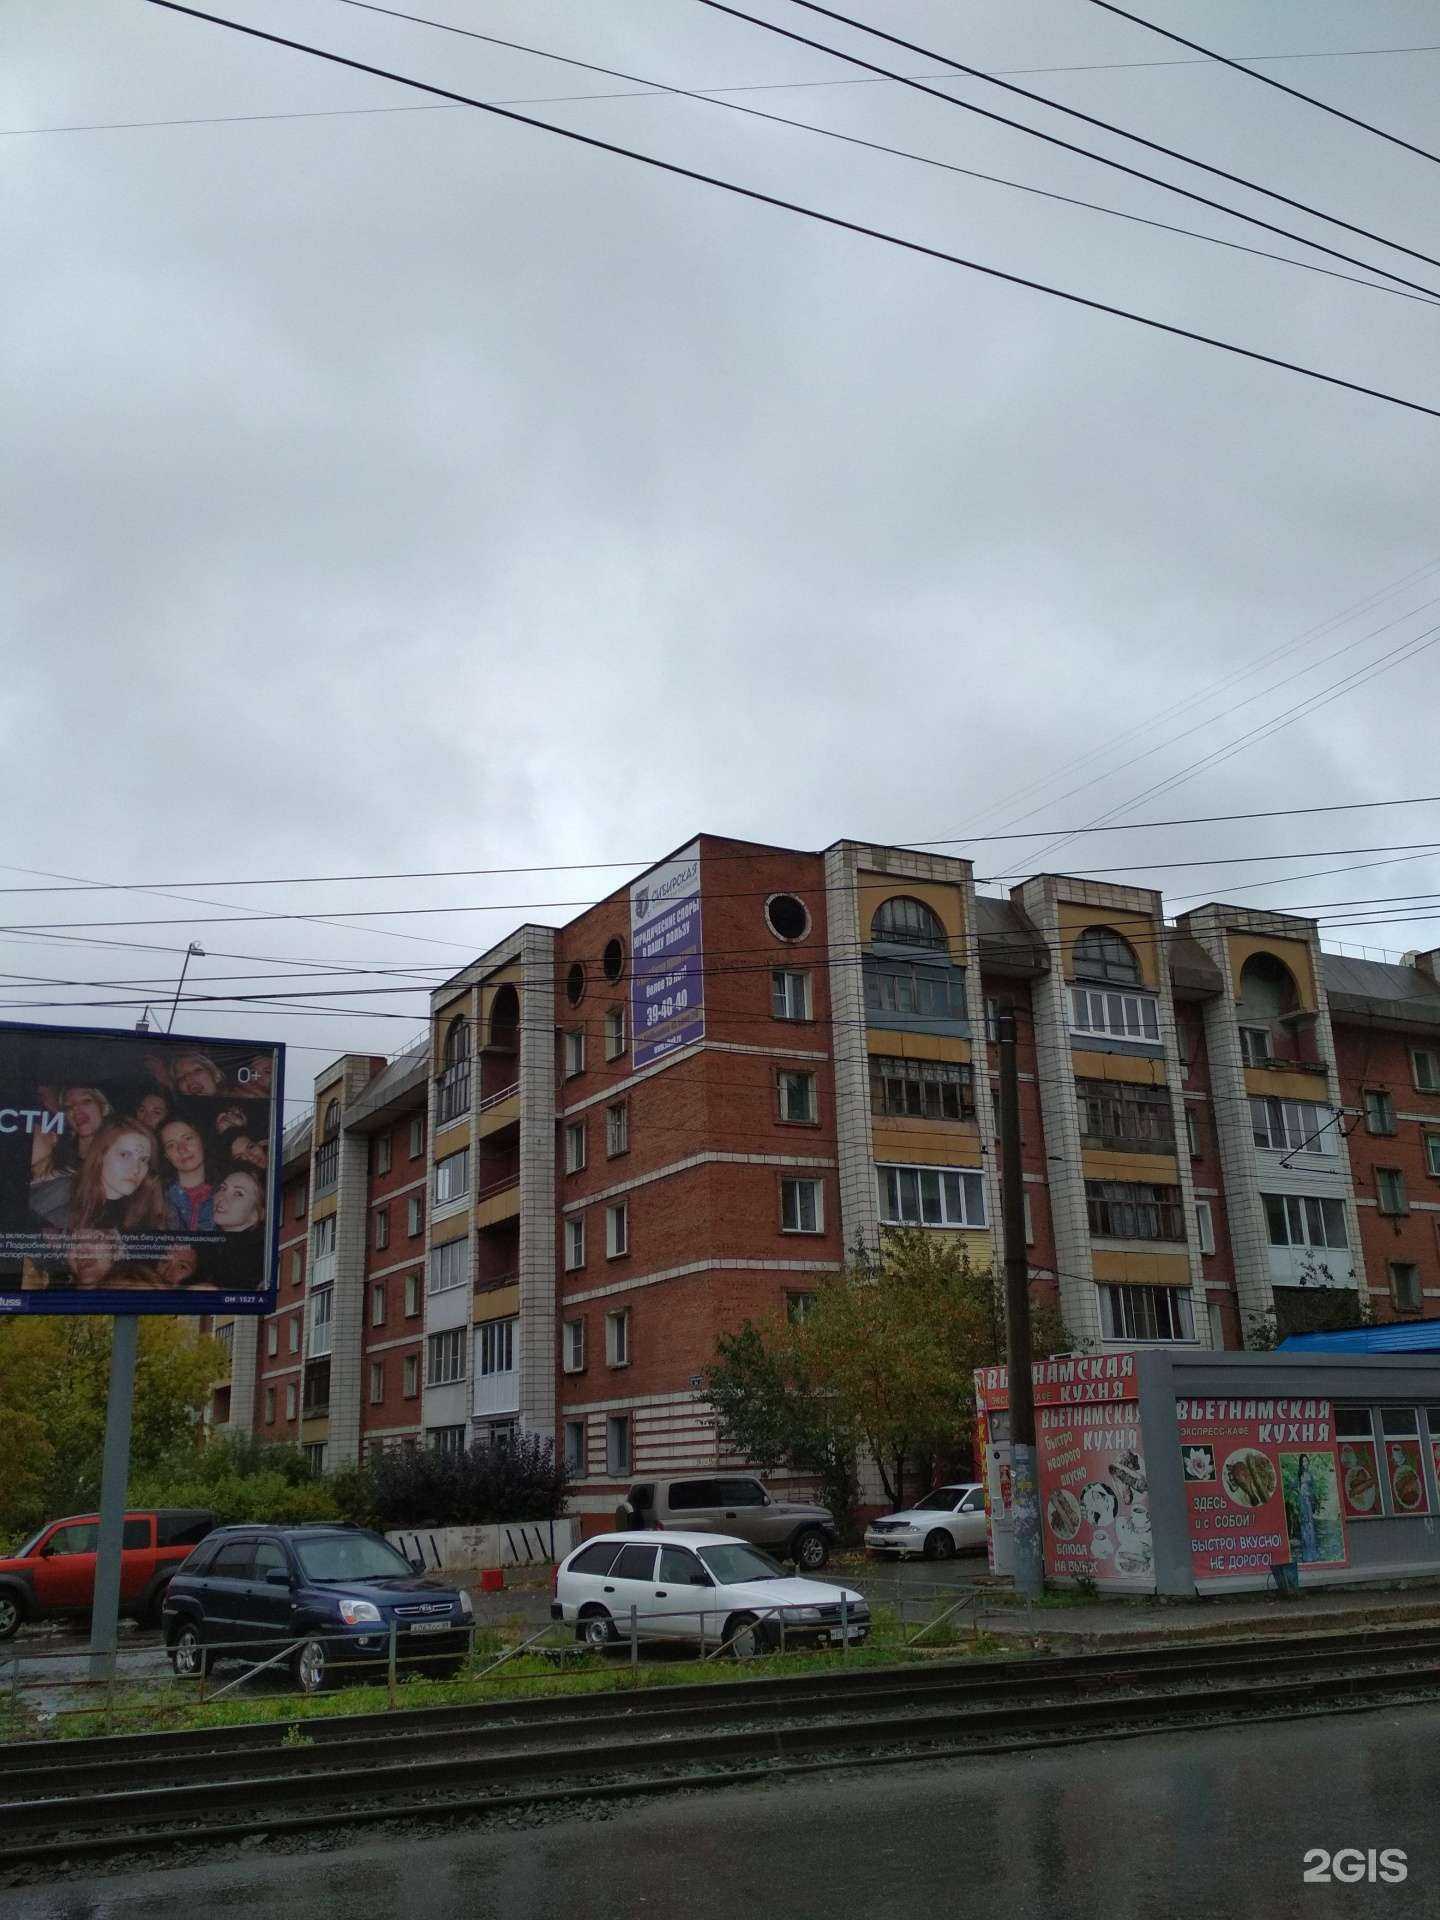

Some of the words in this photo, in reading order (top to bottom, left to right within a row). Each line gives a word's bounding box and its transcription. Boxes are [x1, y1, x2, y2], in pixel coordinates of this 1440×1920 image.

[633, 913, 676, 949] ЮРИДИЧЕСКИЕ
[676, 897, 699, 922] СПОРЫ
[647, 936, 664, 957] ВАШУ
[665, 920, 690, 946] ПОЛЬЗУ
[647, 988, 688, 1027] 39-40-40
[237, 1067, 261, 1083] 0+
[1060, 1381, 1124, 1402] КУХНЯ
[1176, 1400, 1330, 1421] ВЬЕТНАМСКАЯ
[1083, 1429, 1137, 1452] КУХНЯ
[1258, 1423, 1330, 1444] КУХНЯ
[1193, 1496, 1228, 1512] ЗДЕСЬ
[1210, 1556, 1225, 1570] НЕ
